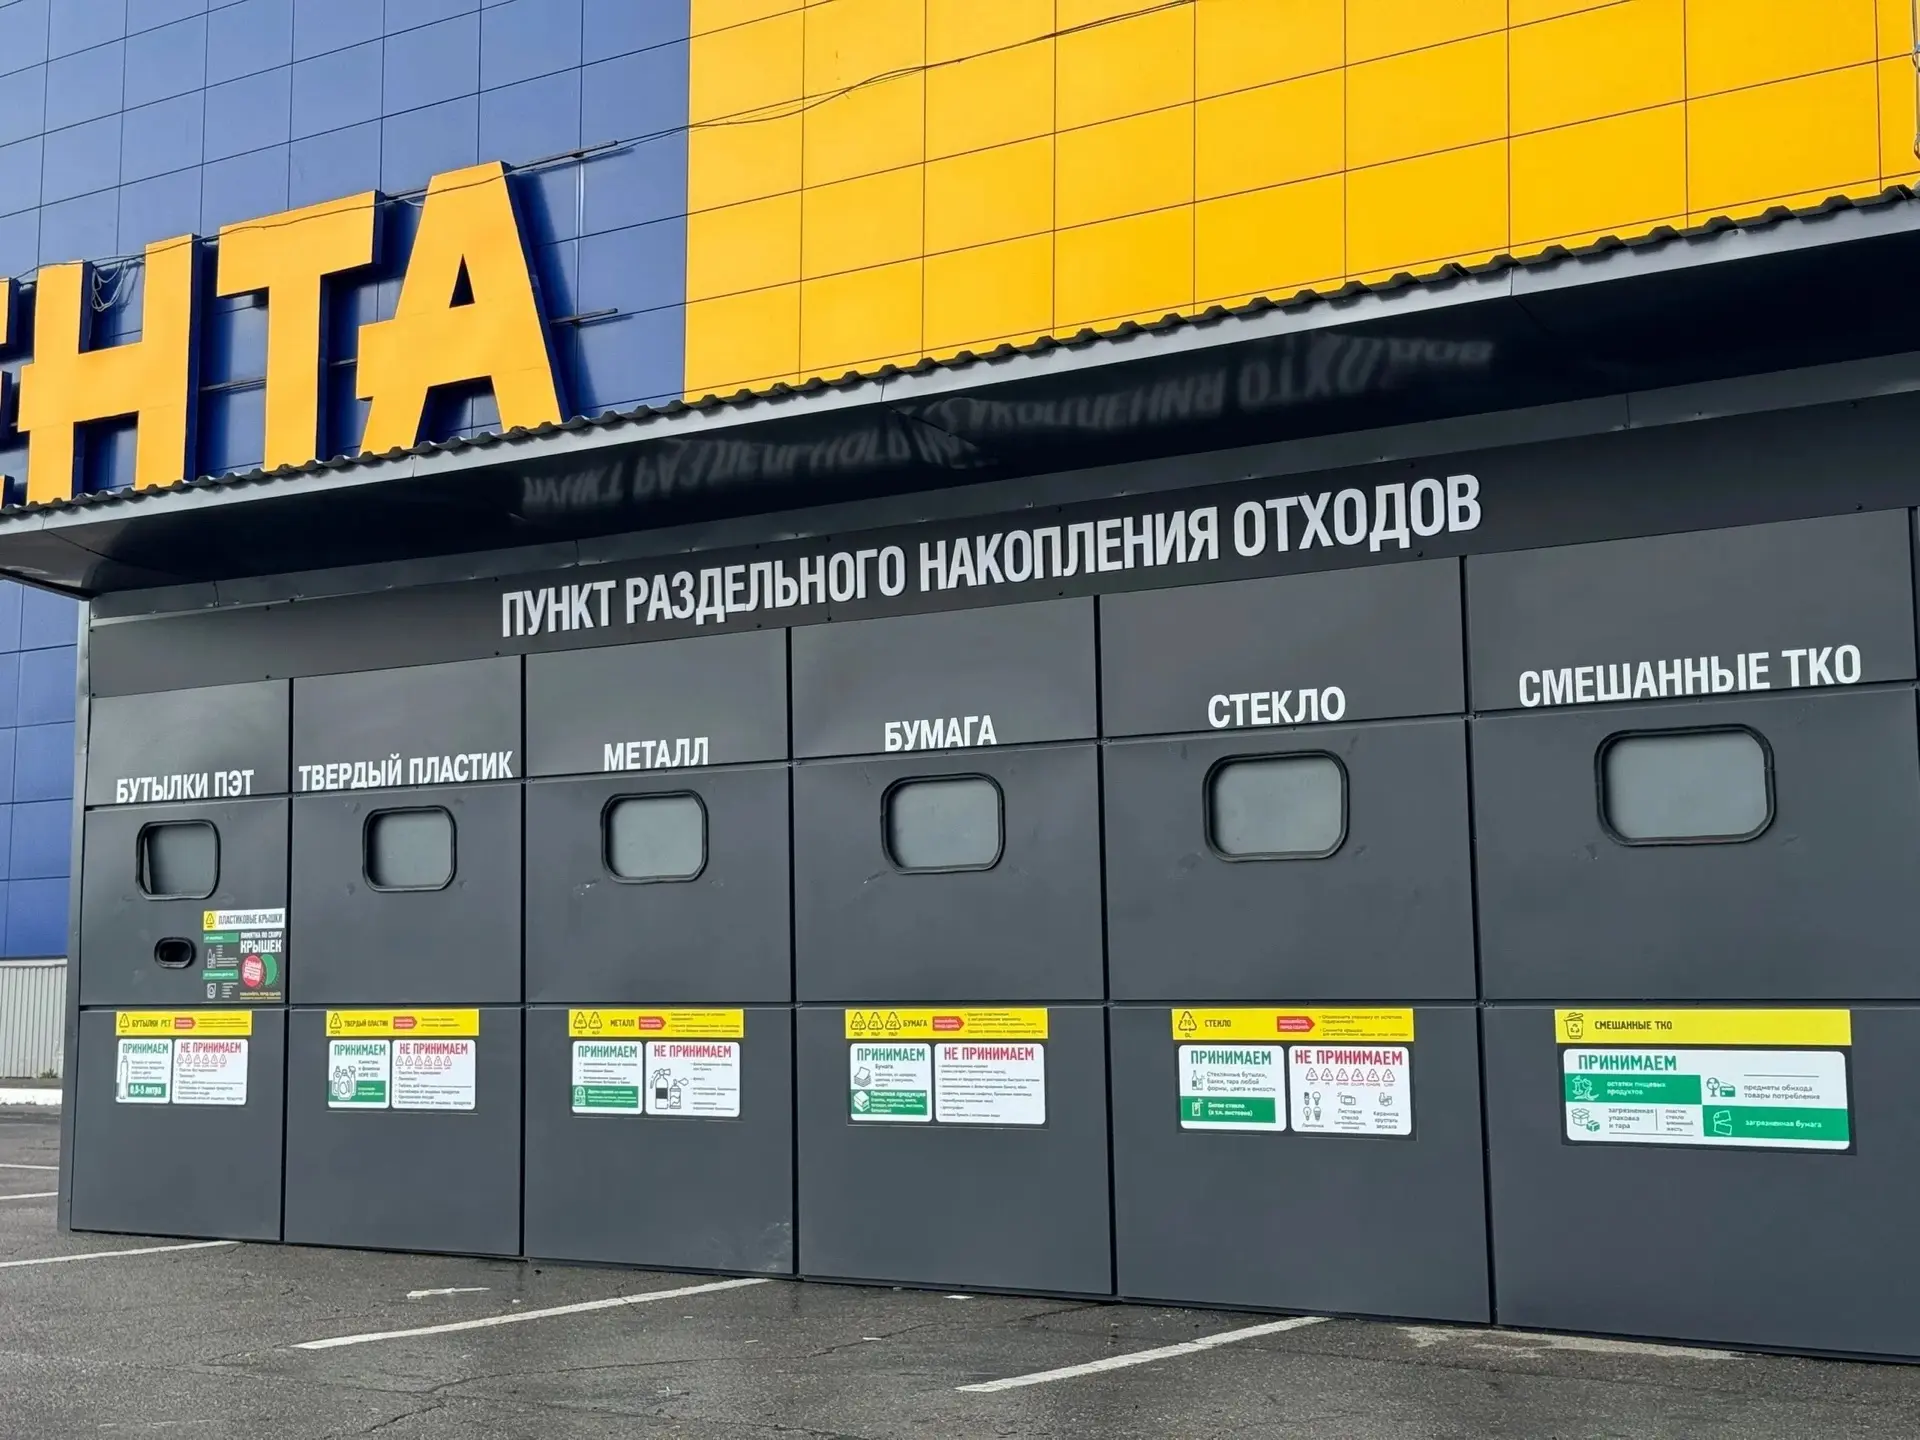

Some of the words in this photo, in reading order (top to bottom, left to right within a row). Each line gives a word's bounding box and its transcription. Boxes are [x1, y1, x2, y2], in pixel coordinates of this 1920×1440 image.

[0, 161, 564, 508] НТА
[502, 580, 616, 638] ПУНКТ
[626, 545, 905, 624] РАЗДЕЛЬНОГО
[919, 506, 1219, 592] НАКОПЛЕНИЯ
[1233, 474, 1482, 557] ОТХОДОВ
[1519, 651, 1772, 708] СМЕШАННЫЕ
[1781, 644, 1863, 688] ТКО
[1207, 686, 1346, 729] СТЕКЛО
[884, 714, 998, 752] БУМАГА
[603, 736, 709, 772] МЕТАЛЛ
[298, 752, 403, 792] ТВЕРДЫЙ
[408, 750, 514, 785] ПЛАСТИК
[114, 772, 208, 804] БУТЫЛКИ
[214, 768, 255, 798] ПЭТ
[218, 914, 257, 925] ПЛАСТИКОВЫЕ
[258, 913, 283, 925] КРЫШКИ
[240, 940, 283, 953] КРЫШЕК
[131, 1019, 159, 1028] БУТЫЛКИ
[344, 1018, 367, 1028] ТВЕРДЫЙ
[610, 1019, 635, 1027] МЕТАЛЛ
[903, 1019, 928, 1028] БУМАГА
[1204, 1019, 1232, 1028] СТЕКЛО
[1594, 1020, 1653, 1030] СМЕШАННЫЕ
[1654, 1020, 1674, 1030] ТКО
[122, 1043, 169, 1054] ПРИНИМАЕМ
[180, 1042, 191, 1053] НЕ
[192, 1042, 241, 1053] ПРИНИМАЕМ
[334, 1044, 386, 1056] ПРИНИМАЕМ
[399, 1043, 412, 1055] НЕ
[413, 1042, 468, 1056] ПРИНИМАЕМ
[578, 1045, 638, 1058] ПРИНИМАЕМ
[653, 1044, 666, 1057] НЕ
[669, 1045, 732, 1058] ПРИНИМАЕМ
[857, 1047, 926, 1061] ПРИНИМАЕМ
[944, 1046, 959, 1060] НЕ
[962, 1046, 1034, 1061] ПРИНИМАЕМ
[1190, 1050, 1272, 1065] ПРИНИМАЕМ
[1295, 1049, 1312, 1065] НЕ
[1316, 1049, 1403, 1066] ПРИНИМАЕМ
[1577, 1054, 1678, 1071] ПРИНИМАЕМ
[1743, 1085, 1781, 1093] предметы
[1781, 1084, 1813, 1092] обихода
[1772, 1092, 1821, 1101] потребления
[1608, 1115, 1640, 1123] упаковка
[1745, 1119, 1795, 1128] загрязненная
[1795, 1120, 1823, 1129] бумага
